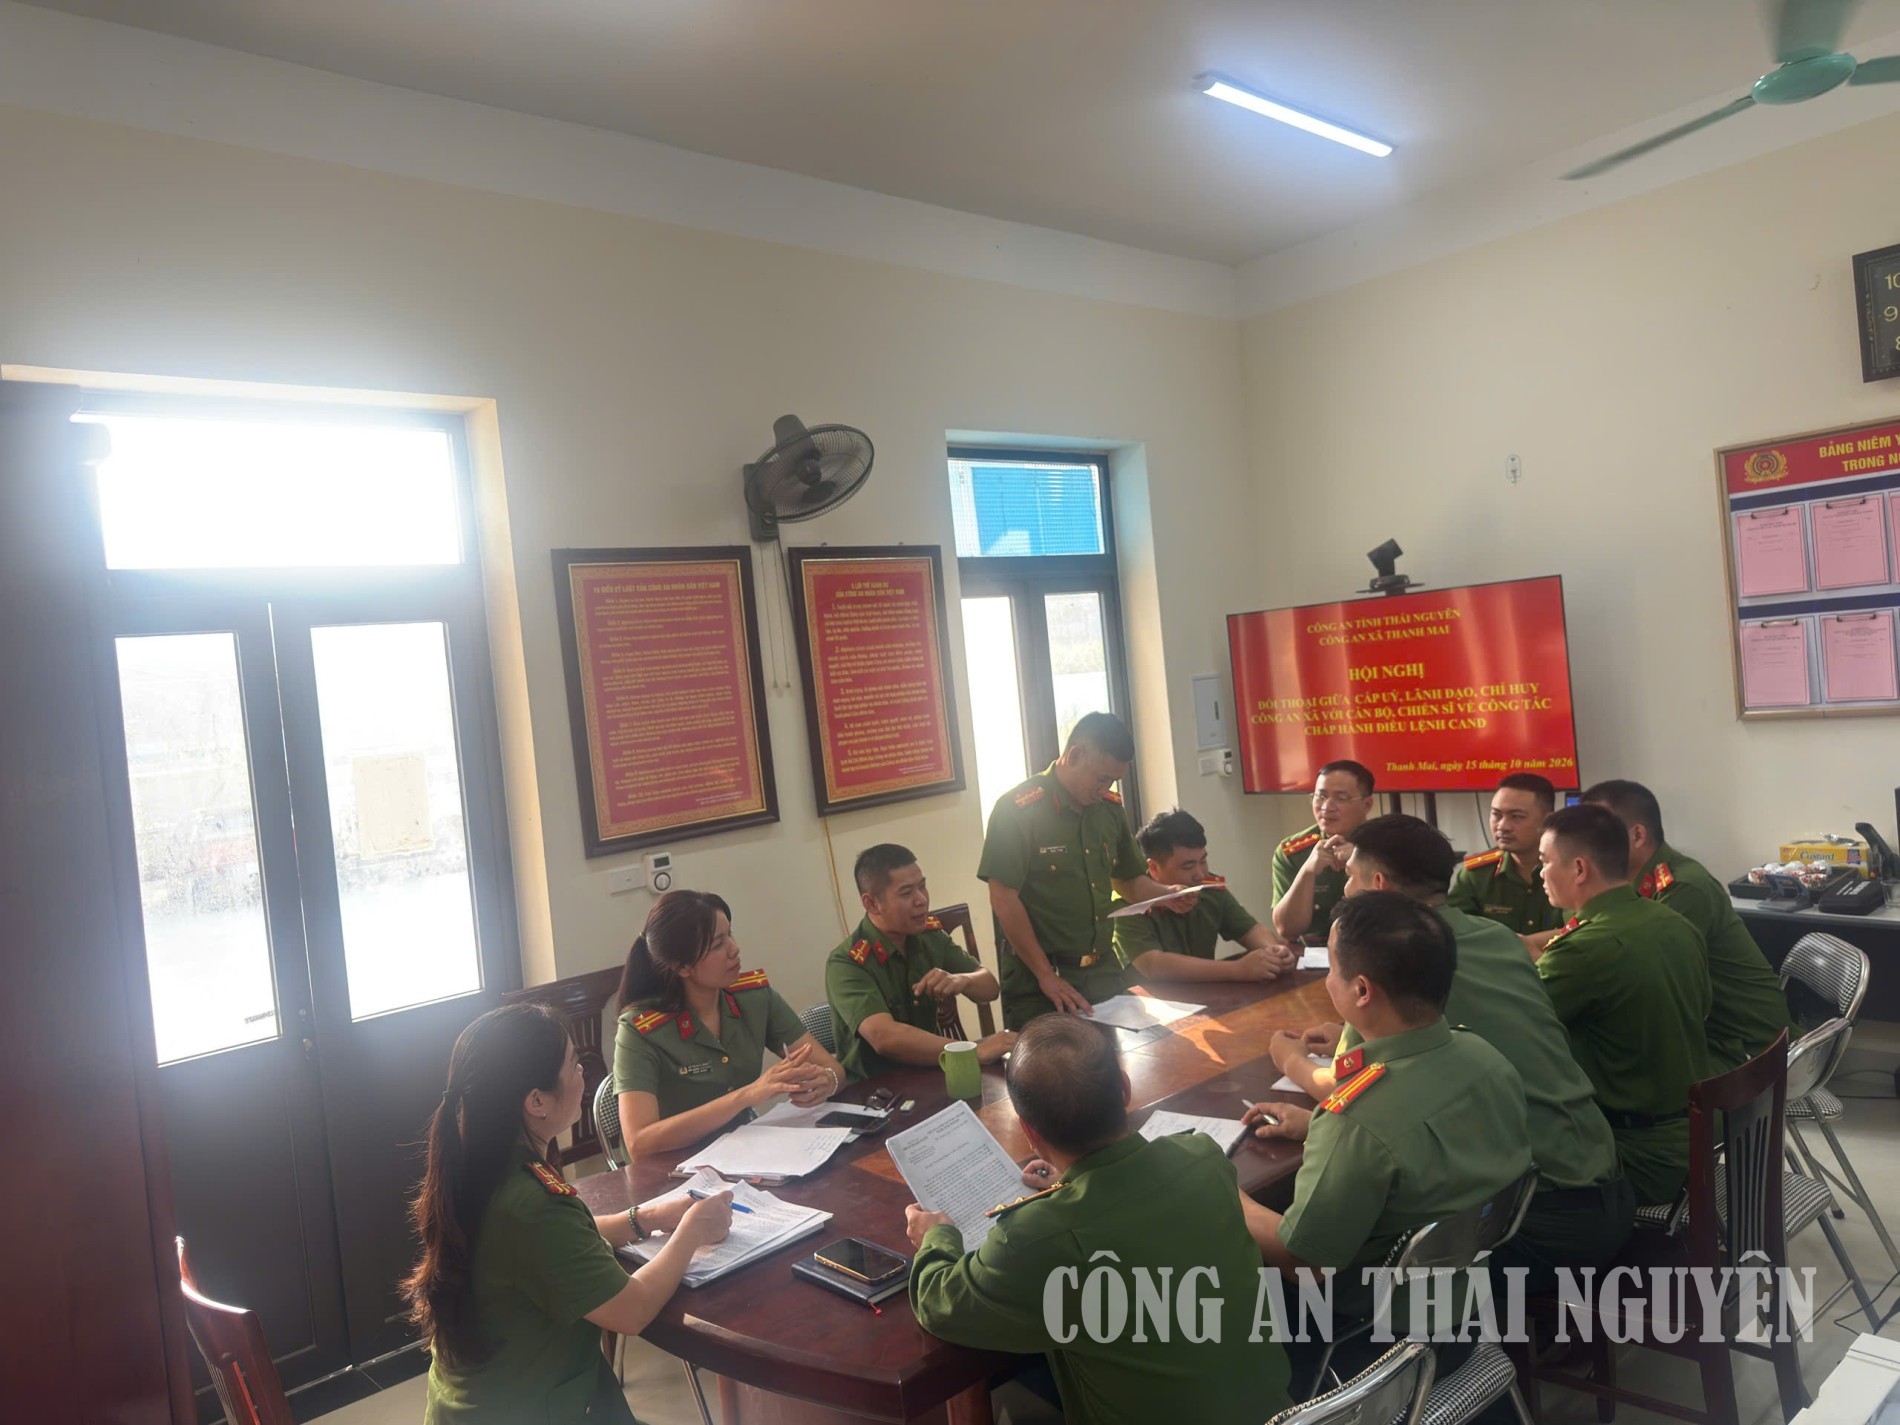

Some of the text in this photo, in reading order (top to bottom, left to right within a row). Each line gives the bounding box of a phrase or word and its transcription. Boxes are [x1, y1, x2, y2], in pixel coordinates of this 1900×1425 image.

[1884, 306, 1898, 321] 9
[1819, 440, 1854, 458] BẢNG
[1842, 454, 1885, 472] TRONG
[1307, 621, 1337, 634] CÔNG
[1339, 620, 1353, 631] AN
[1383, 613, 1411, 626] THÁI
[1413, 607, 1461, 623] NGUYÊN
[1319, 624, 1450, 647] CÔNG AN XÃ THANH MAI
[1349, 662, 1425, 682] HỘI NGHỊ
[1405, 688, 1442, 701] LÃNH
[1444, 687, 1478, 701] ĐẠO,
[1509, 682, 1540, 694] HUY
[1251, 712, 1283, 725] CÔNG
[1286, 711, 1300, 722] AN
[1303, 709, 1319, 721] XÃ
[1346, 706, 1371, 719] CÁN
[1478, 698, 1519, 713] CÔNG
[1522, 696, 1552, 710] TÁC
[1338, 722, 1373, 735] HÀNH
[1410, 719, 1445, 734] LỆNH
[1448, 717, 1487, 730] CAND
[1386, 757, 1574, 772] Thanh Mai, ngày 15 tháng 10 năm 2026
